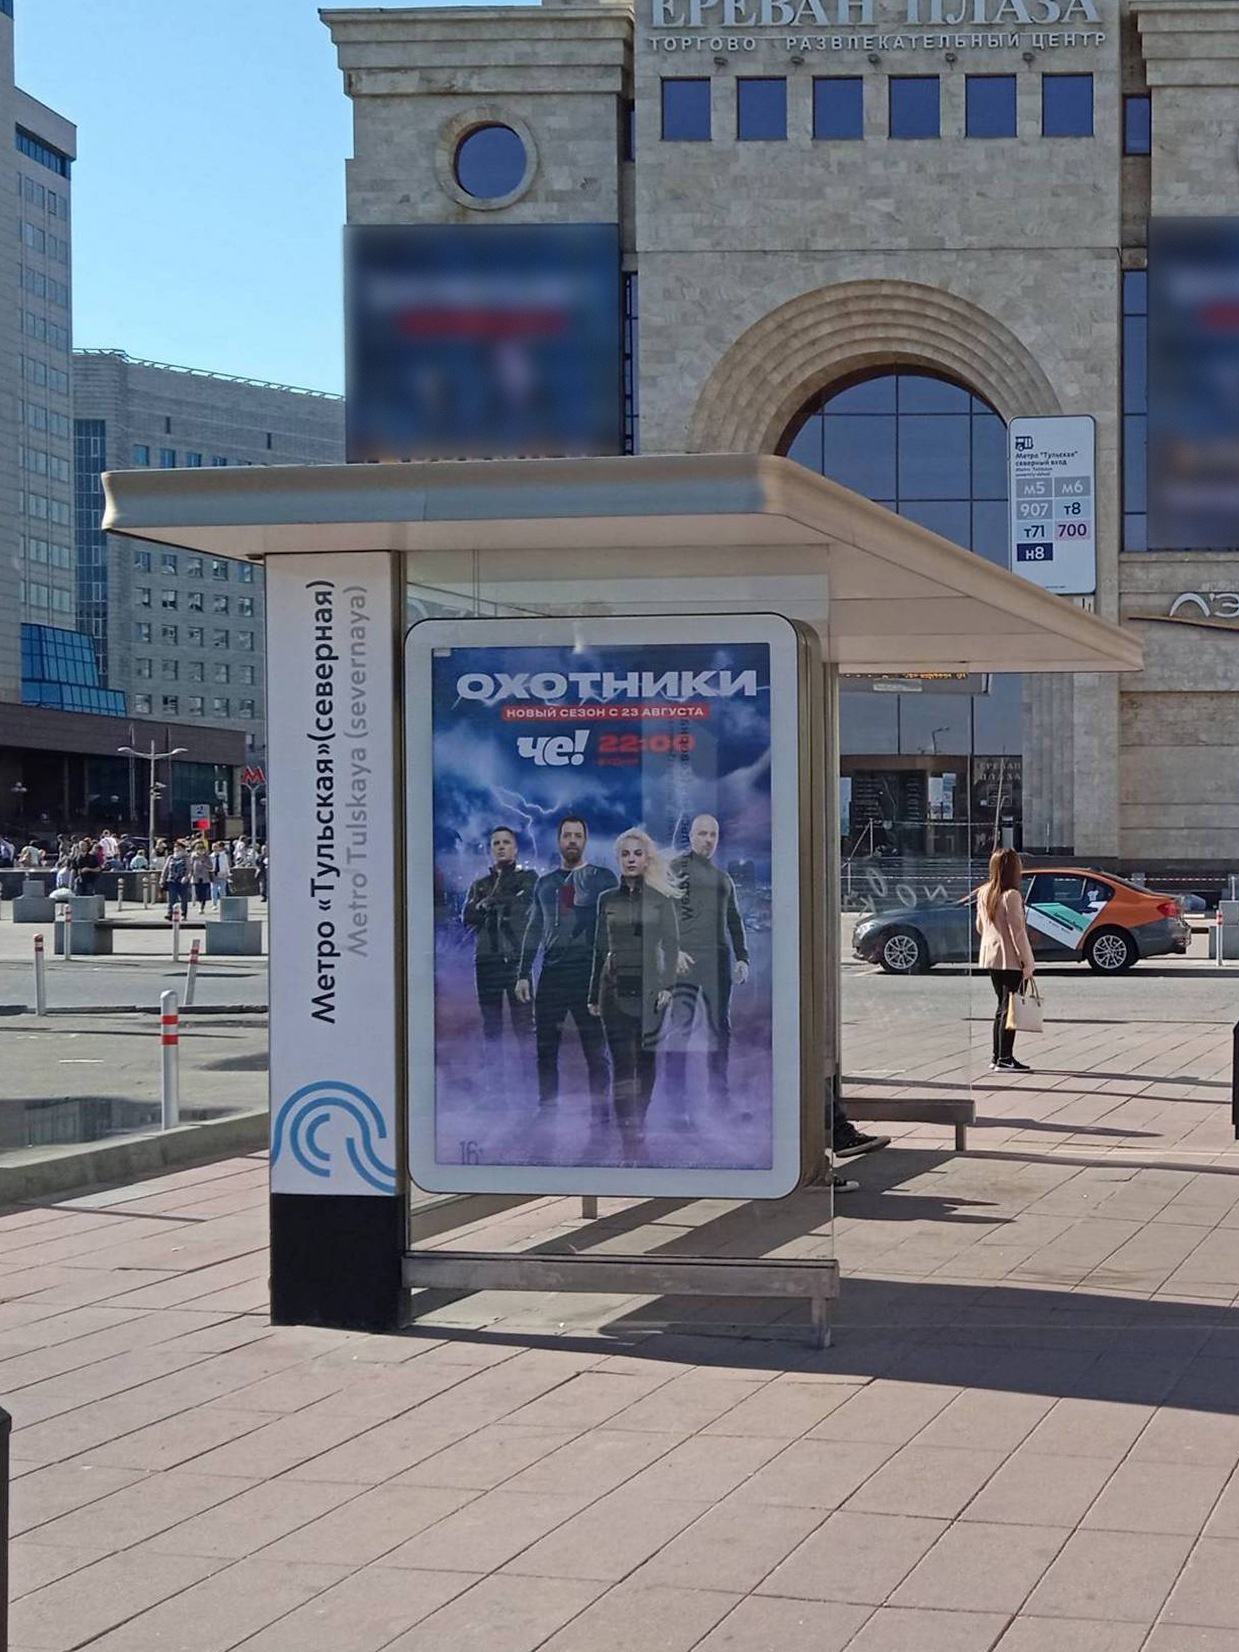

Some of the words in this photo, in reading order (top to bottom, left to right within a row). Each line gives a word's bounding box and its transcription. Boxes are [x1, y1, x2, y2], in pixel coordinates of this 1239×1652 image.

[651, 0, 878, 27] ЕРЕВАН
[904, 0, 1103, 25] ПЛАЗА
[650, 37, 756, 50] ТОРГОВО
[786, 32, 1019, 50] РАЗВЛЕКАТЕЛЬНЫЙ
[1032, 32, 1107, 50] ЦЕНТР
[1020, 503, 1048, 517] 907
[1058, 524, 1087, 537] 700
[342, 586, 371, 739] (severnaya)
[457, 670, 757, 699] ОХОТНИКИ
[506, 706, 557, 718] НОВЫЙ
[560, 707, 605, 718] СЕЗОН
[609, 707, 618, 717] С
[621, 706, 638, 717] 23
[642, 706, 704, 717] АВГУСТА
[599, 733, 697, 753] 22:00
[344, 747, 372, 865] Tulskaya
[346, 872, 368, 958] Metro
[310, 920, 341, 1024] Метро
